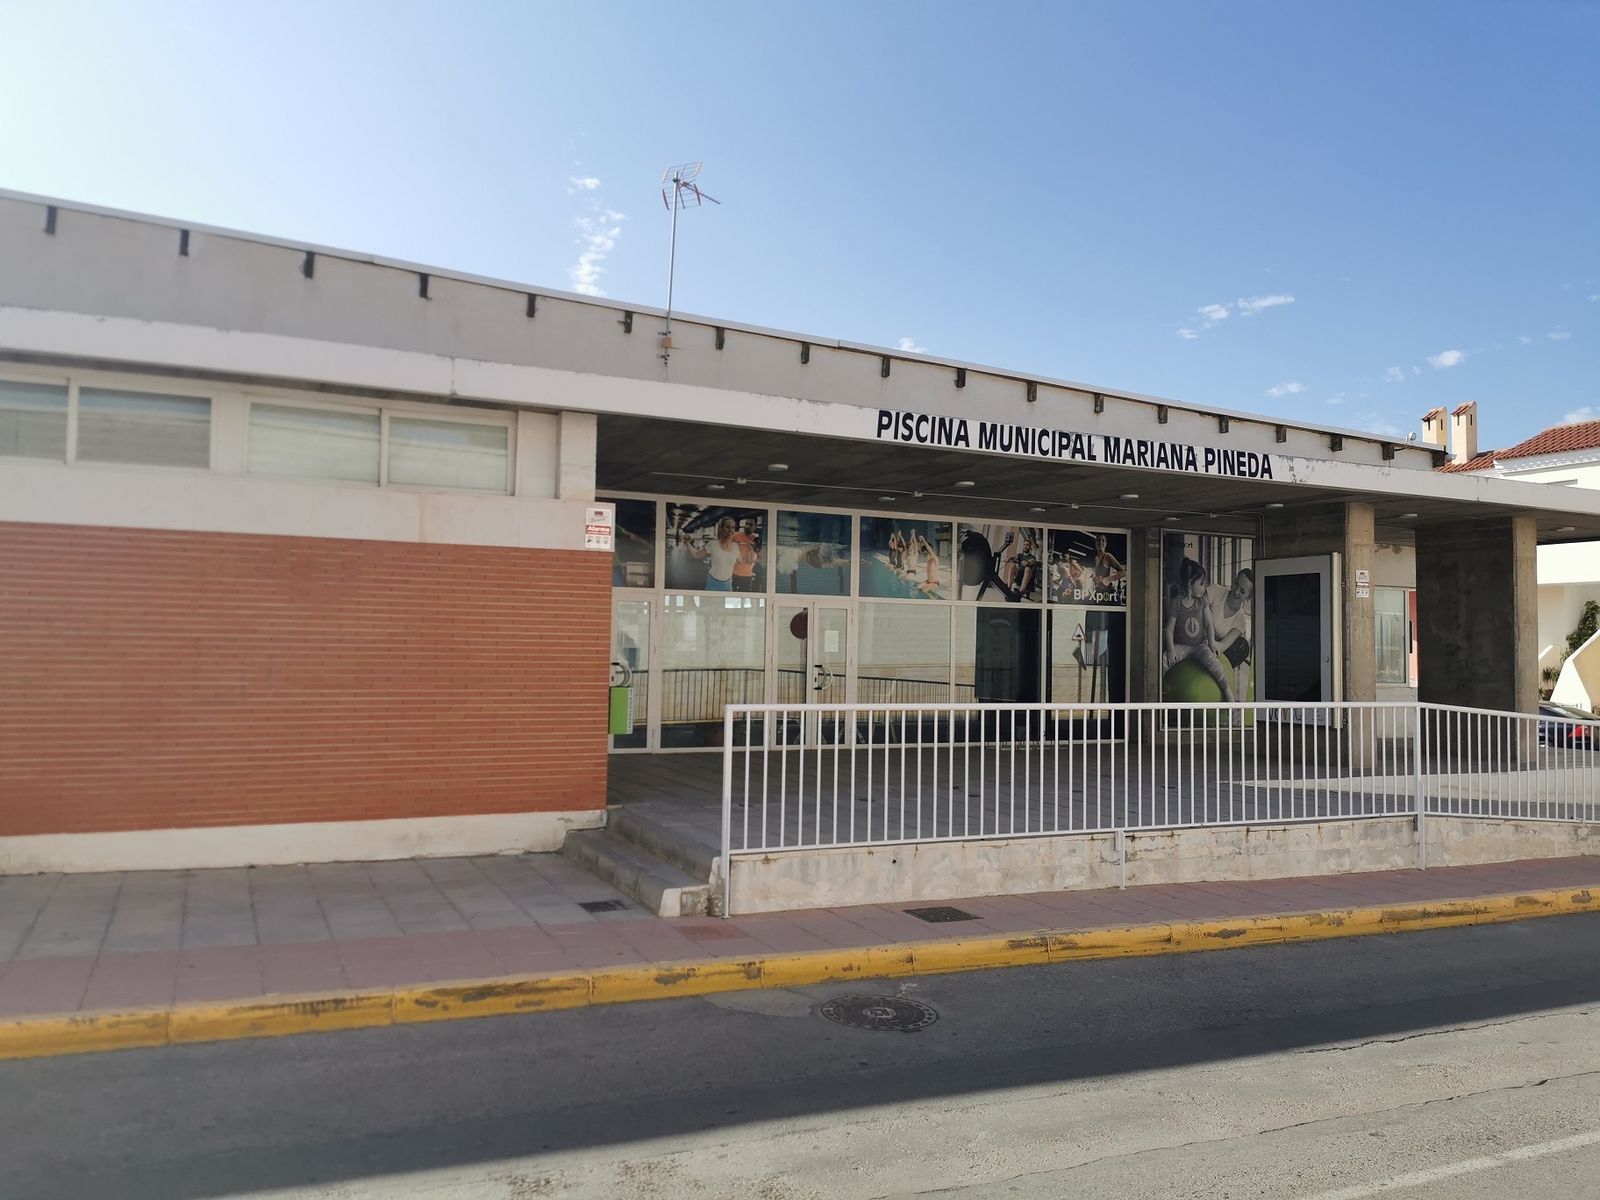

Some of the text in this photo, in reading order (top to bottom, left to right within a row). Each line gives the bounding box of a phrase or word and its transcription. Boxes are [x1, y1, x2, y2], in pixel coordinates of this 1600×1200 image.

[877, 410, 1273, 480] PISCINA MUNICIPAL MARIANA PINEDA
